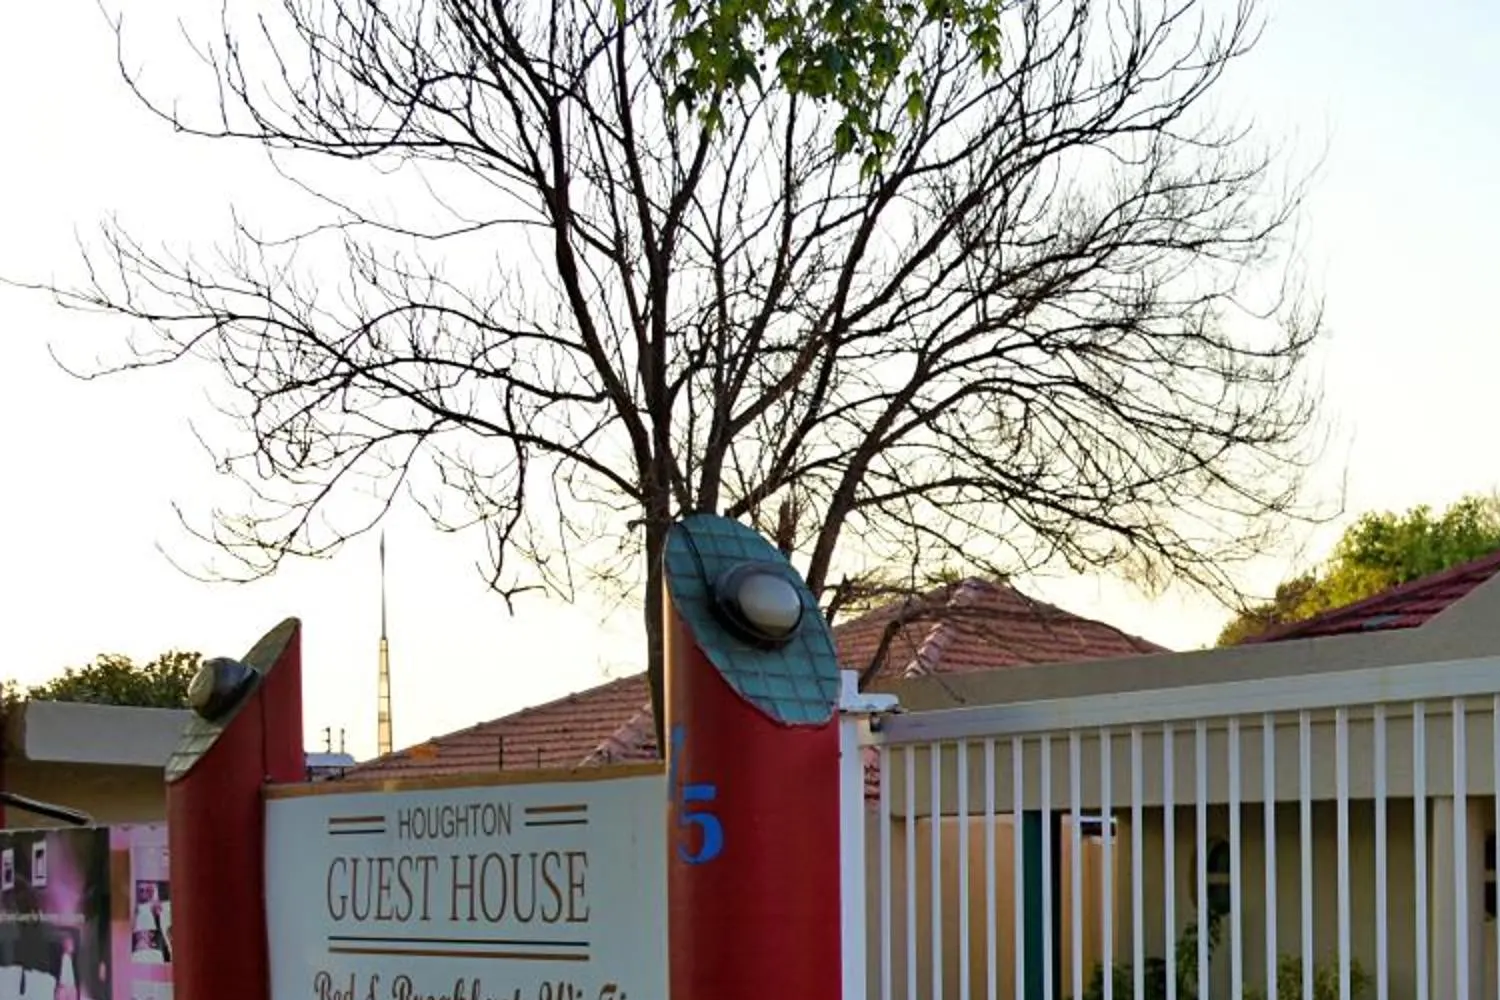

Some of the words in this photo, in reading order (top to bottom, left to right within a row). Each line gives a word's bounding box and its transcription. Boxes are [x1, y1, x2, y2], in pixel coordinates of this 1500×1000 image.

[398, 802, 511, 839] HOUGHTON
[327, 855, 438, 921] GUEST
[449, 850, 590, 923] HOUSE
